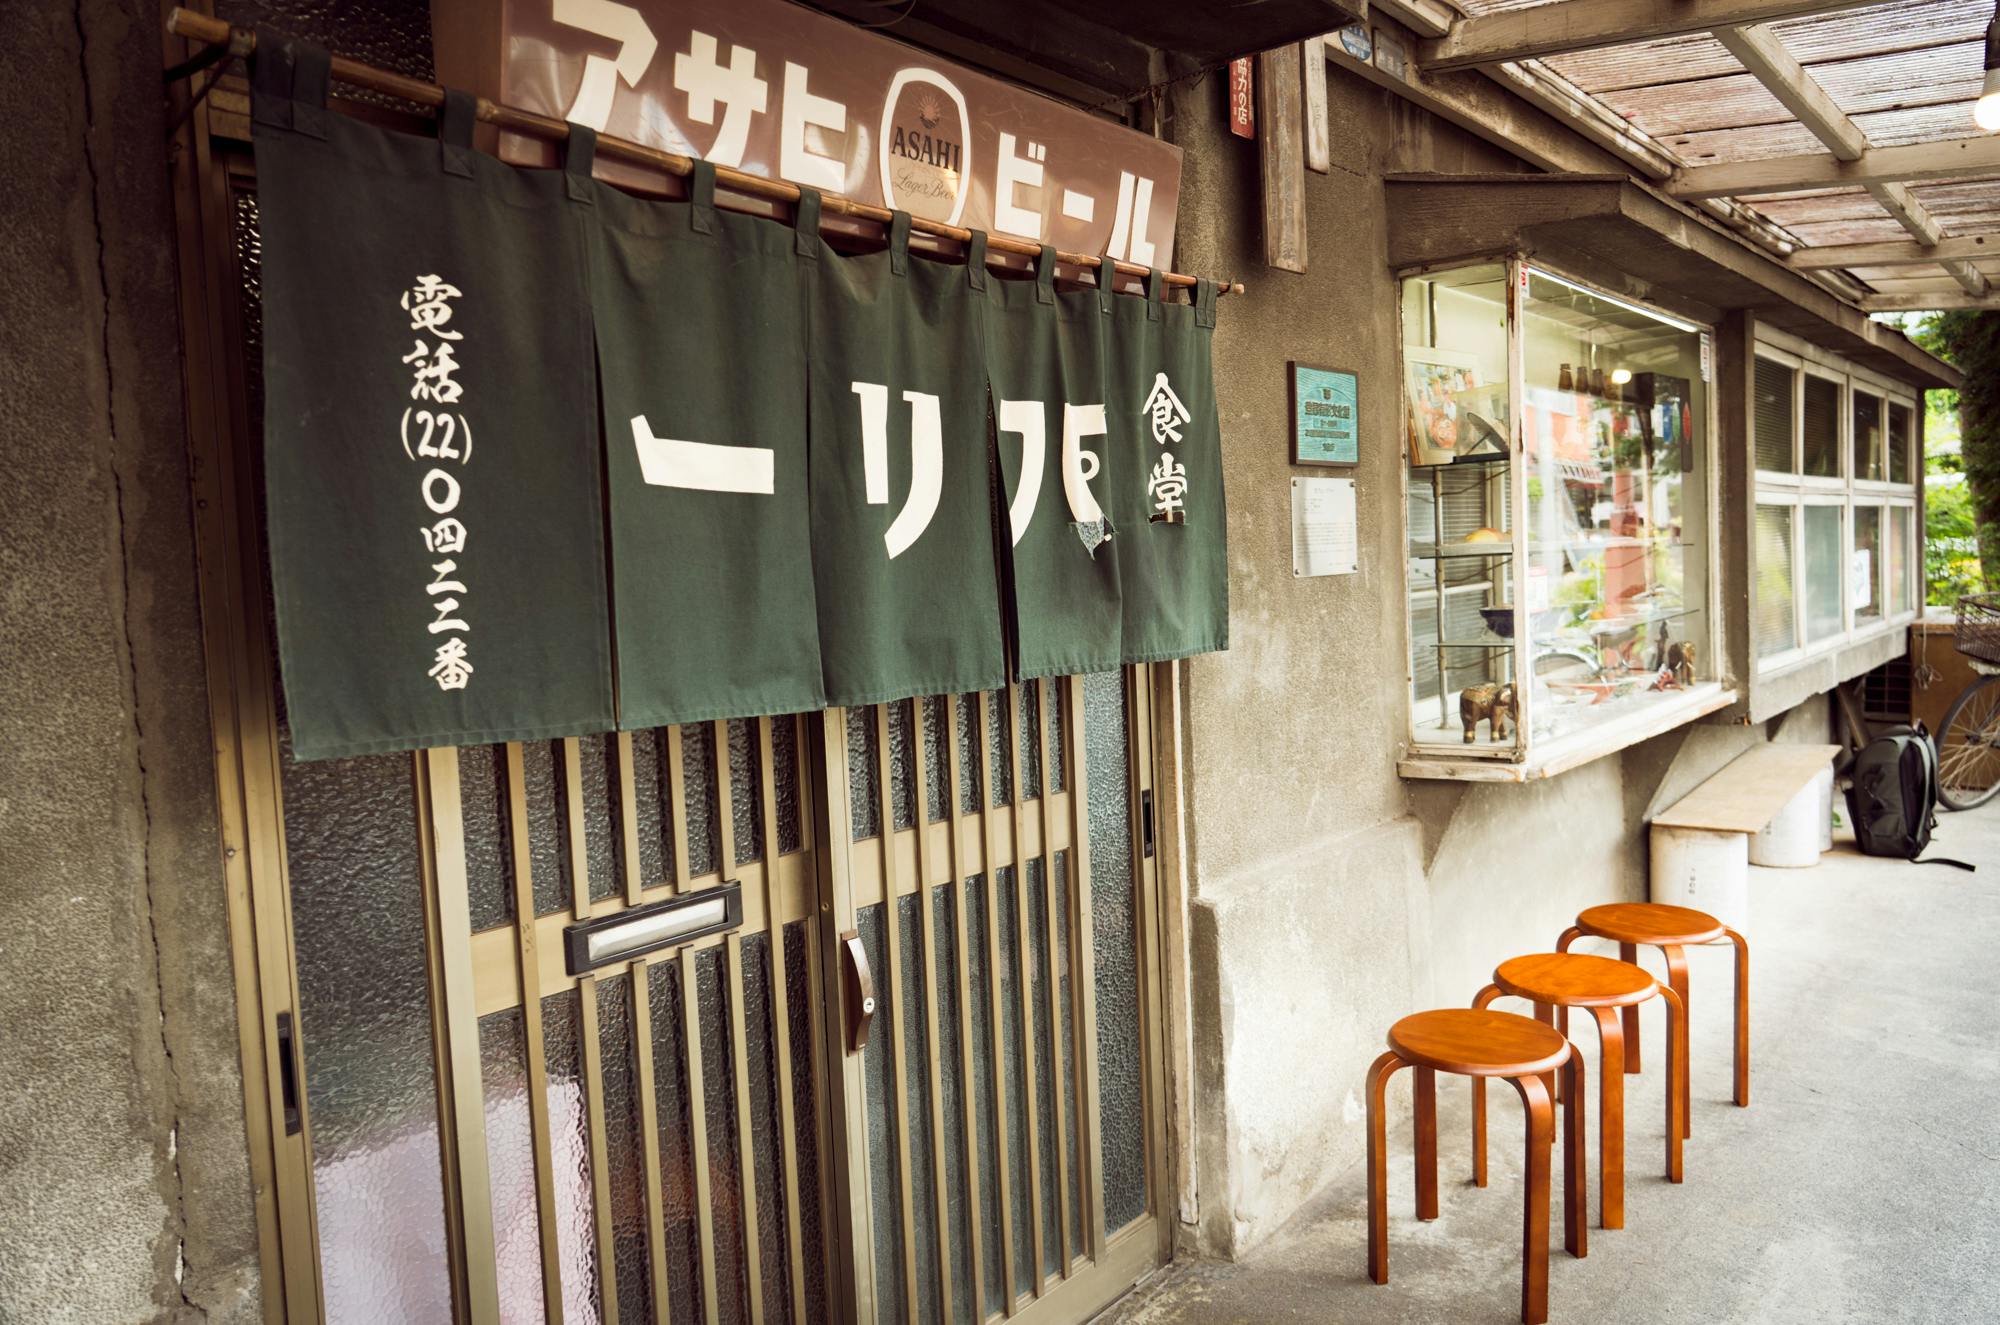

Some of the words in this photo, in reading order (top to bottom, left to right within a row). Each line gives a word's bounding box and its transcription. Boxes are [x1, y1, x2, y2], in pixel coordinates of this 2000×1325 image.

[552, 0, 847, 194] アサヒ
[994, 131, 1156, 268] ビール
[891, 126, 960, 172] ASAHI
[893, 167, 929, 197] Lager
[1143, 372, 1191, 522] 食堂
